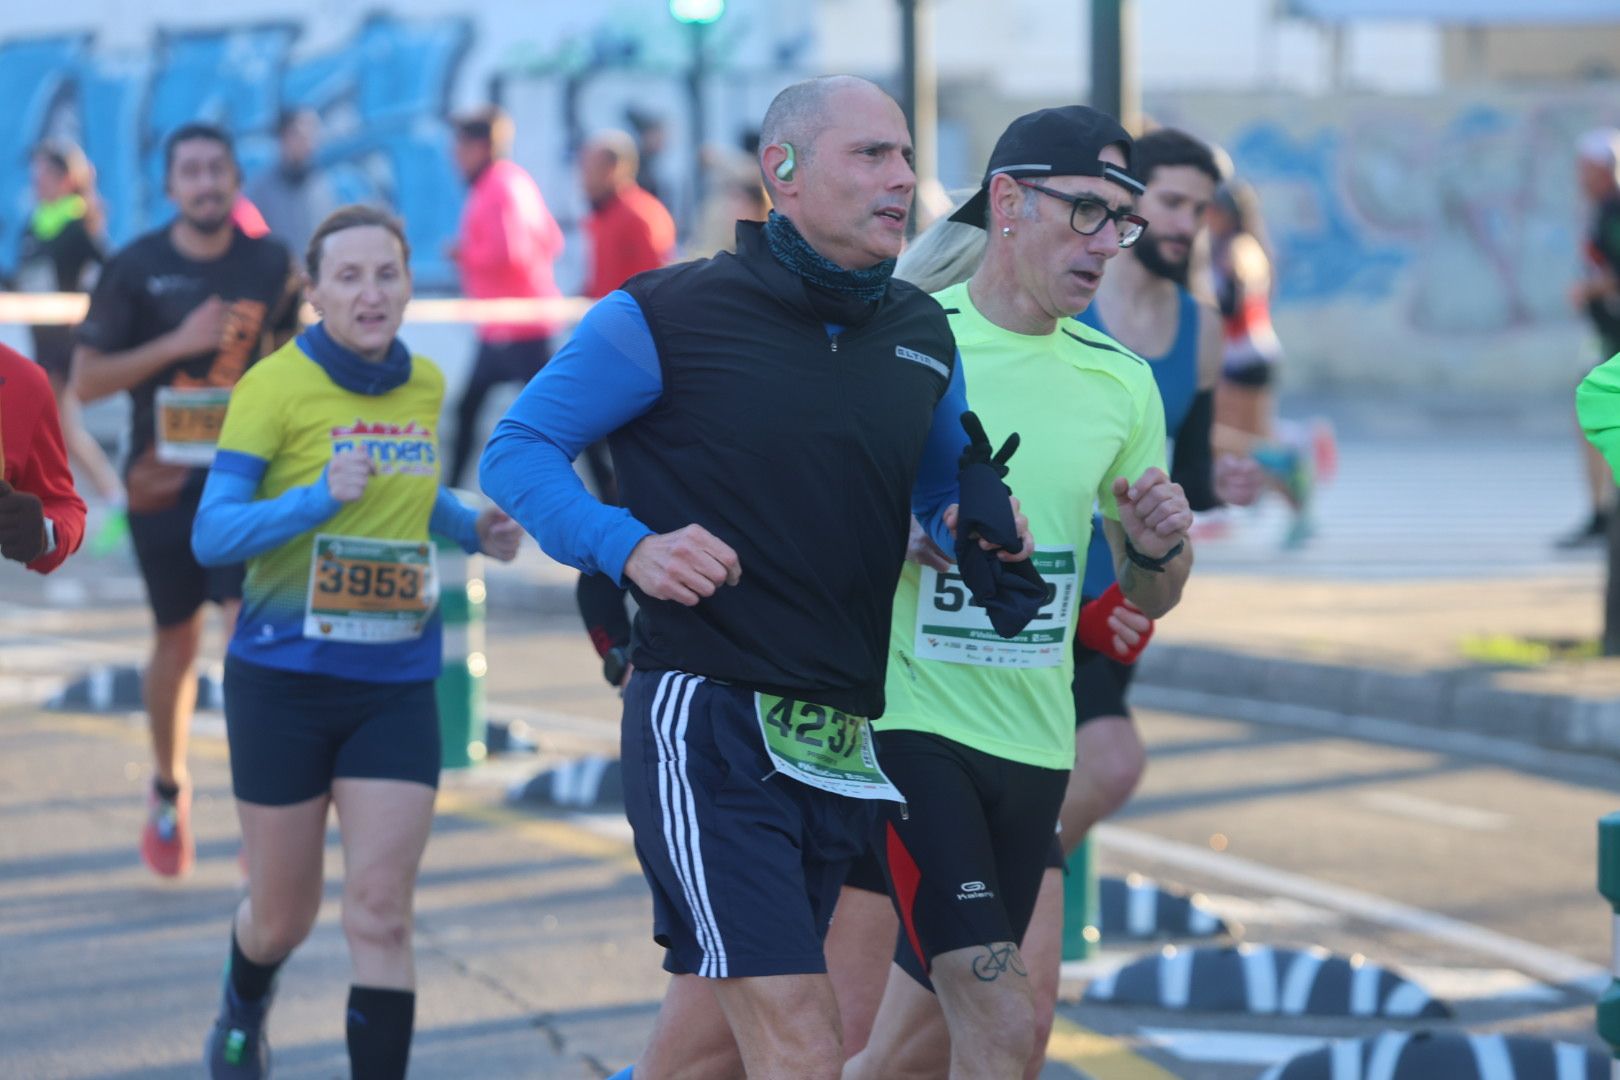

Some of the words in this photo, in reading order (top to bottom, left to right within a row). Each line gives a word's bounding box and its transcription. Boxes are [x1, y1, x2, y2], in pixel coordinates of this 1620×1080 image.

[318, 559, 419, 600] 3953
[933, 572, 1057, 620] 52
[766, 697, 861, 758] 4237
